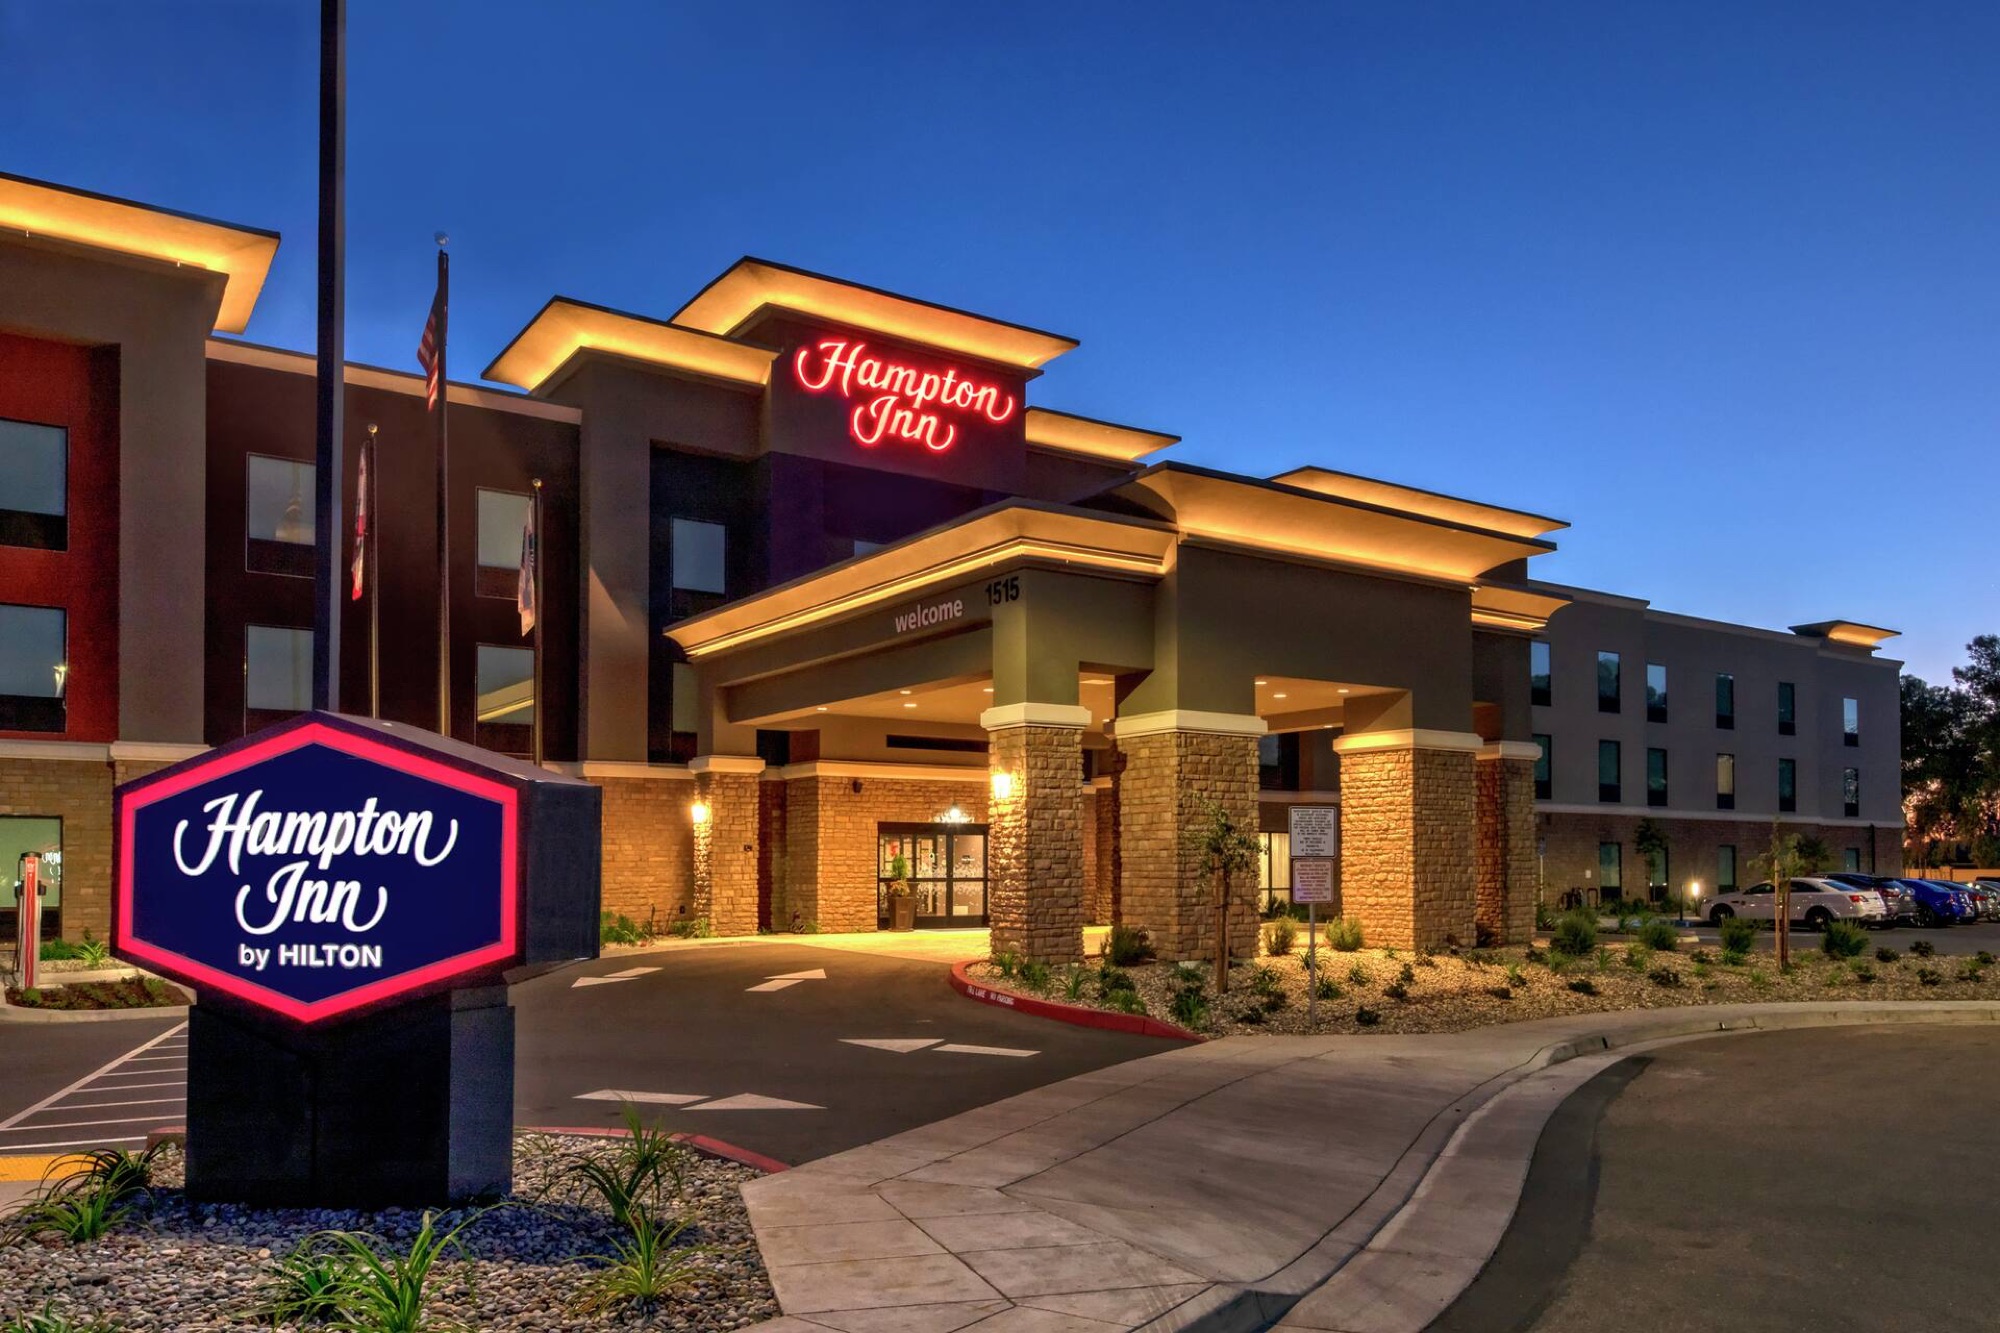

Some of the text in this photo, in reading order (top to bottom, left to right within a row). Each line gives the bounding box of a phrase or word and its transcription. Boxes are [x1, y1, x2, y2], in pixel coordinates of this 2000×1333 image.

[797, 341, 1014, 421] Hampton
[853, 395, 955, 451] Inn
[895, 599, 964, 633] welcome
[985, 576, 1020, 607] 1515
[173, 789, 459, 877] Hampton
[235, 860, 388, 935] Inn
[239, 943, 382, 971] by HILTON
